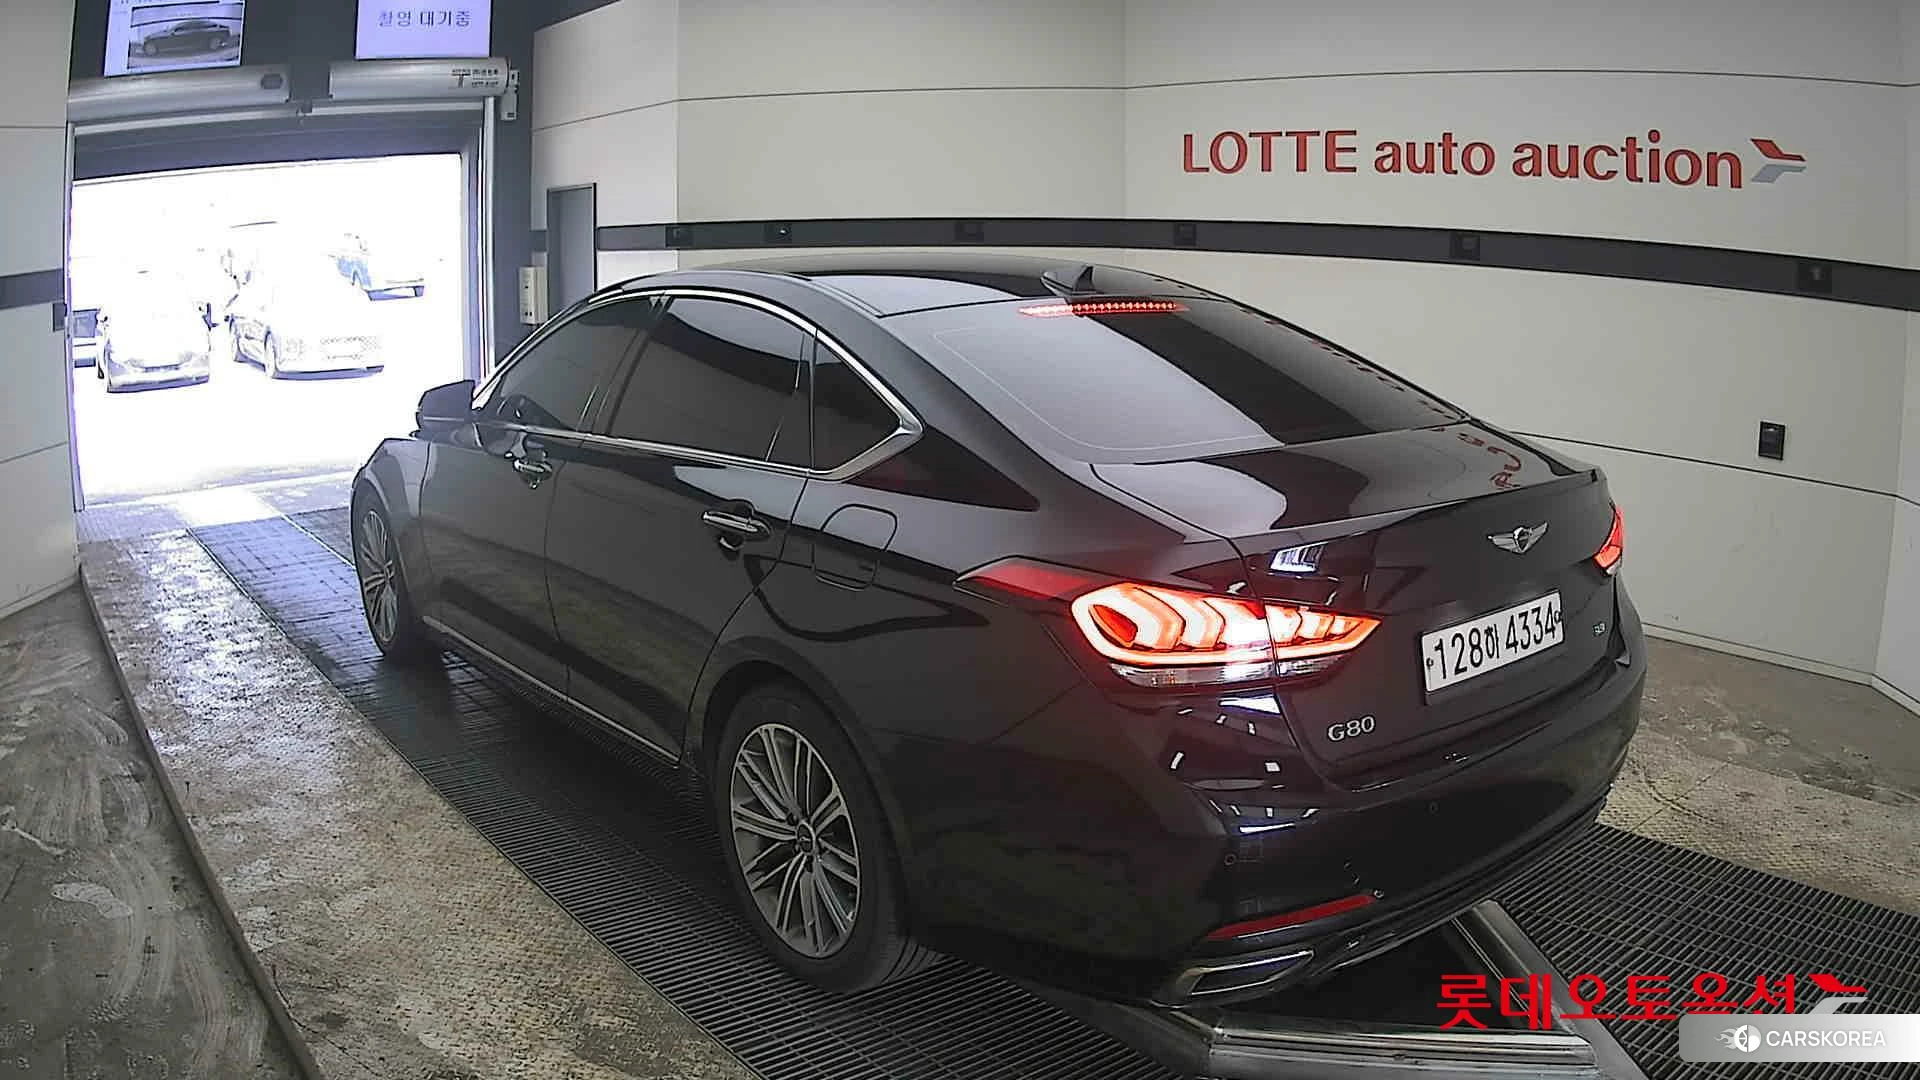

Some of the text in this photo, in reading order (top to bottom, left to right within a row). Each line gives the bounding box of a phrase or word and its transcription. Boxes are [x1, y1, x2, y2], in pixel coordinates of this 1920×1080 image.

[419, 10, 472, 27] 대기중
[1183, 130, 1743, 189] LOTTE auto auction
[1434, 601, 1557, 680] 128하 4334
[1327, 715, 1375, 742] G80
